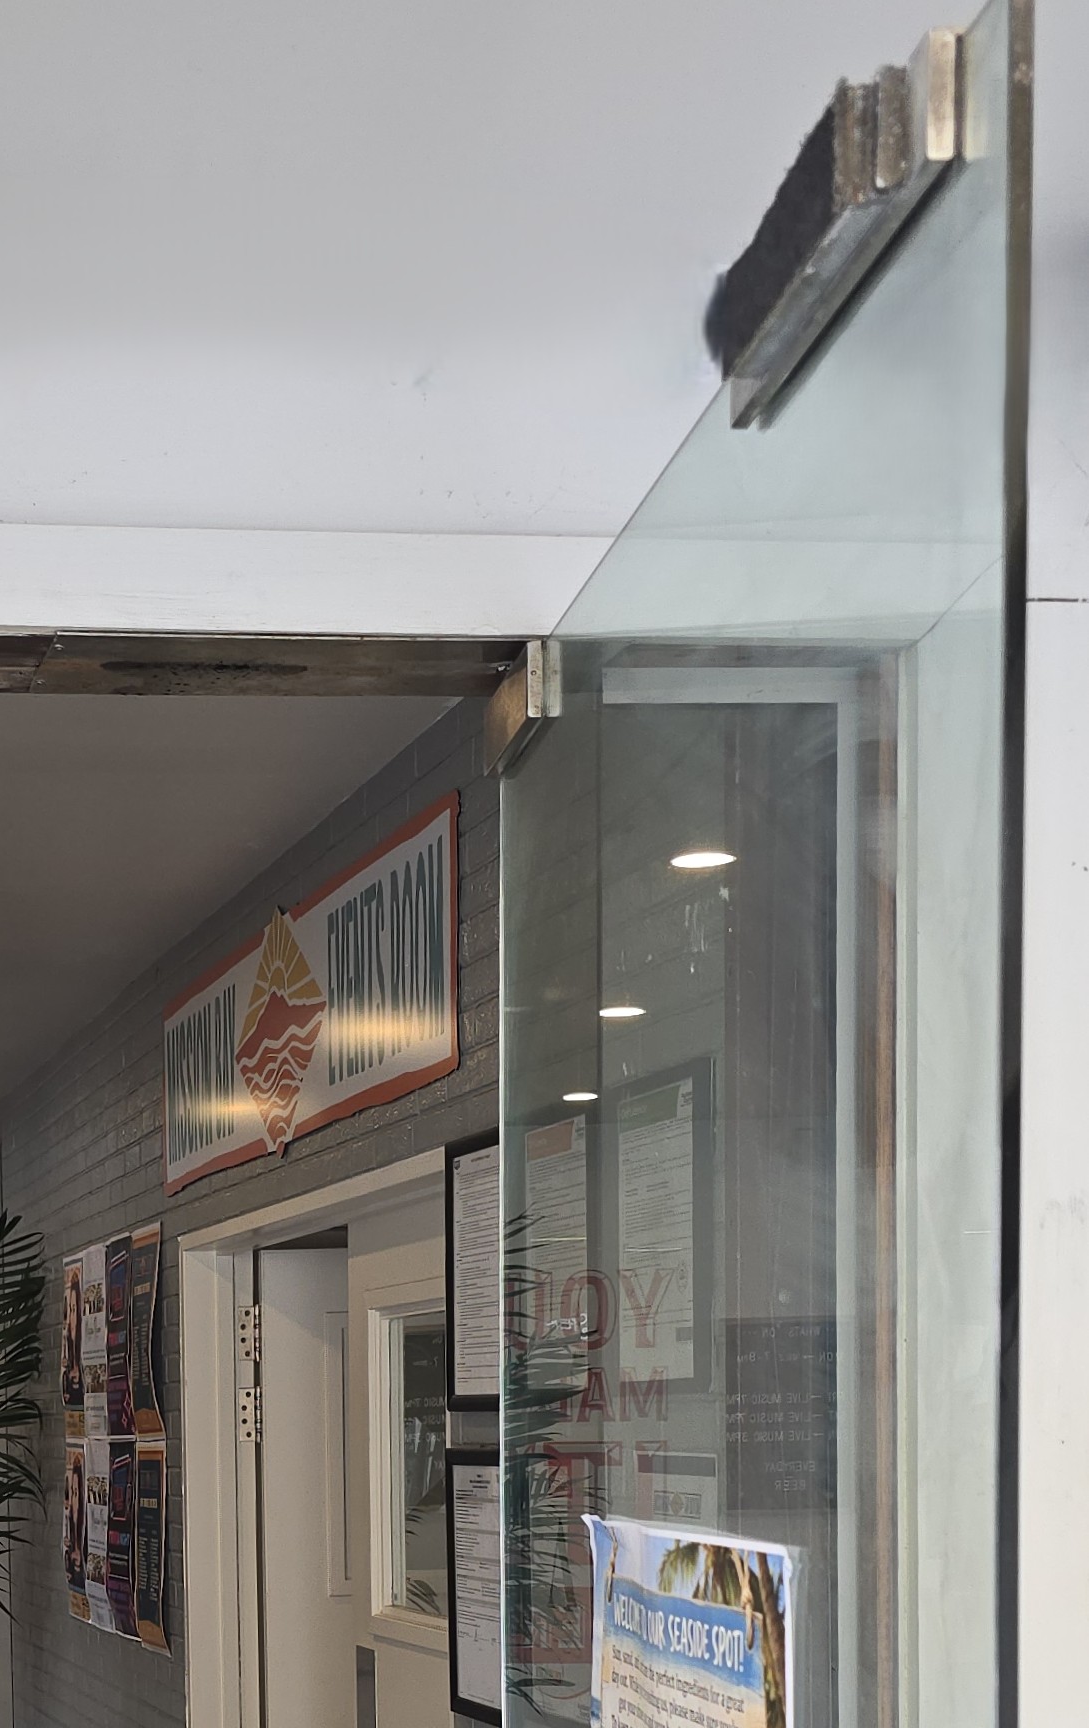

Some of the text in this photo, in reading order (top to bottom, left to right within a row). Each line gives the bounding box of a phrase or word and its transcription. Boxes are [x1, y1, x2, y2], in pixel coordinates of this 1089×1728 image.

[327, 834, 444, 1086] EVENTS ROOM
[166, 983, 236, 1166] MISSION BAY
[648, 1609, 666, 1651] OUR
[668, 1614, 710, 1660] SEASIDE
[712, 1625, 744, 1673] SPOT!
[656, 1670, 675, 1688] perfect
[676, 1673, 709, 1701] ingredients
[710, 1685, 719, 1705] for
[726, 1695, 744, 1714] great
[669, 1698, 688, 1719] please
[689, 1707, 705, 1727] make
